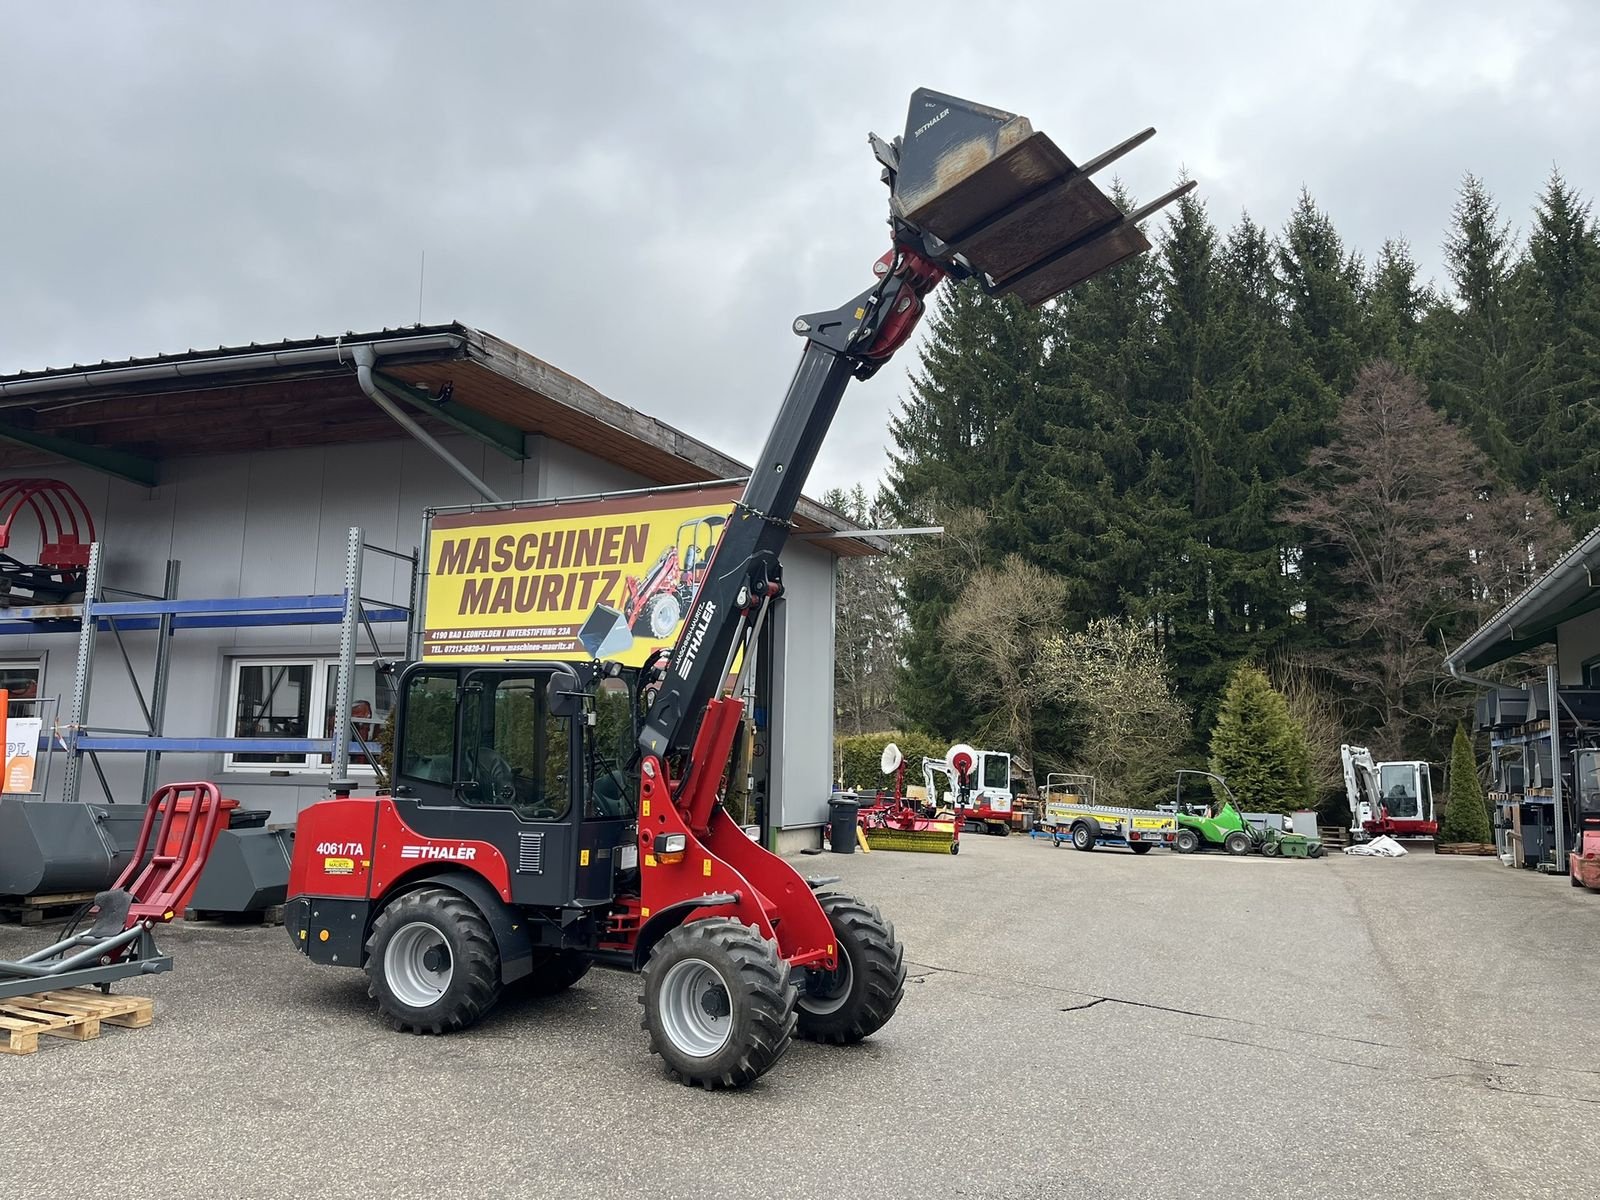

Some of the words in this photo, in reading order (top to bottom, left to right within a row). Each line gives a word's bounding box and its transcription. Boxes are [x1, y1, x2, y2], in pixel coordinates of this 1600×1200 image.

[921, 108, 950, 131] THALER
[436, 523, 650, 575] MASCHINEN
[458, 570, 622, 616] MAURITZ
[431, 631, 448, 639] 4190
[448, 631, 461, 639] BAD
[462, 629, 502, 639] LEONFELDEN
[506, 628, 556, 637] UNTERSTIFTUNG
[557, 627, 571, 636] 23A
[687, 600, 717, 660] THALER
[431, 645, 443, 653] TEL.
[490, 642, 575, 653] www.maschinen-mauritz.at
[316, 842, 364, 856] 4061/TA
[420, 846, 477, 860] THALER
